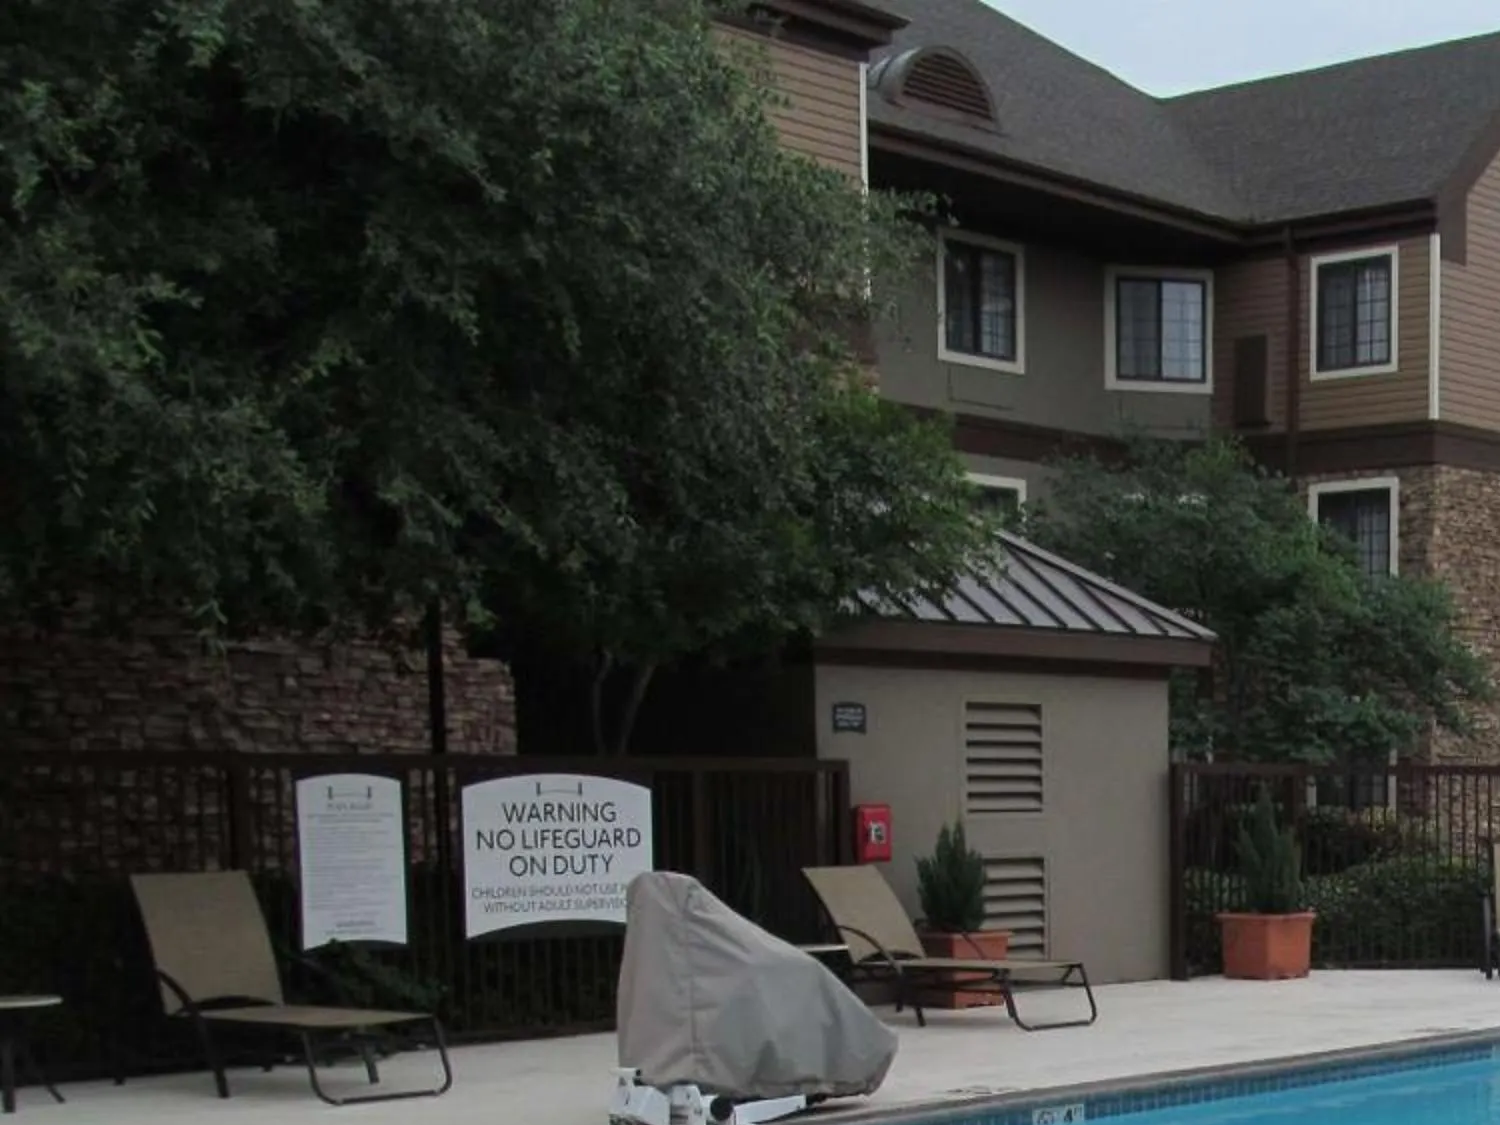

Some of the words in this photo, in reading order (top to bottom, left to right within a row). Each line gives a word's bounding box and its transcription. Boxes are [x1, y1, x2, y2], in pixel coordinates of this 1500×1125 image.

[502, 802, 617, 824] WARNING
[476, 829, 515, 850] NO
[521, 827, 641, 849] LIFEGUARD
[509, 855, 547, 876] ON
[553, 854, 614, 875] DUTY
